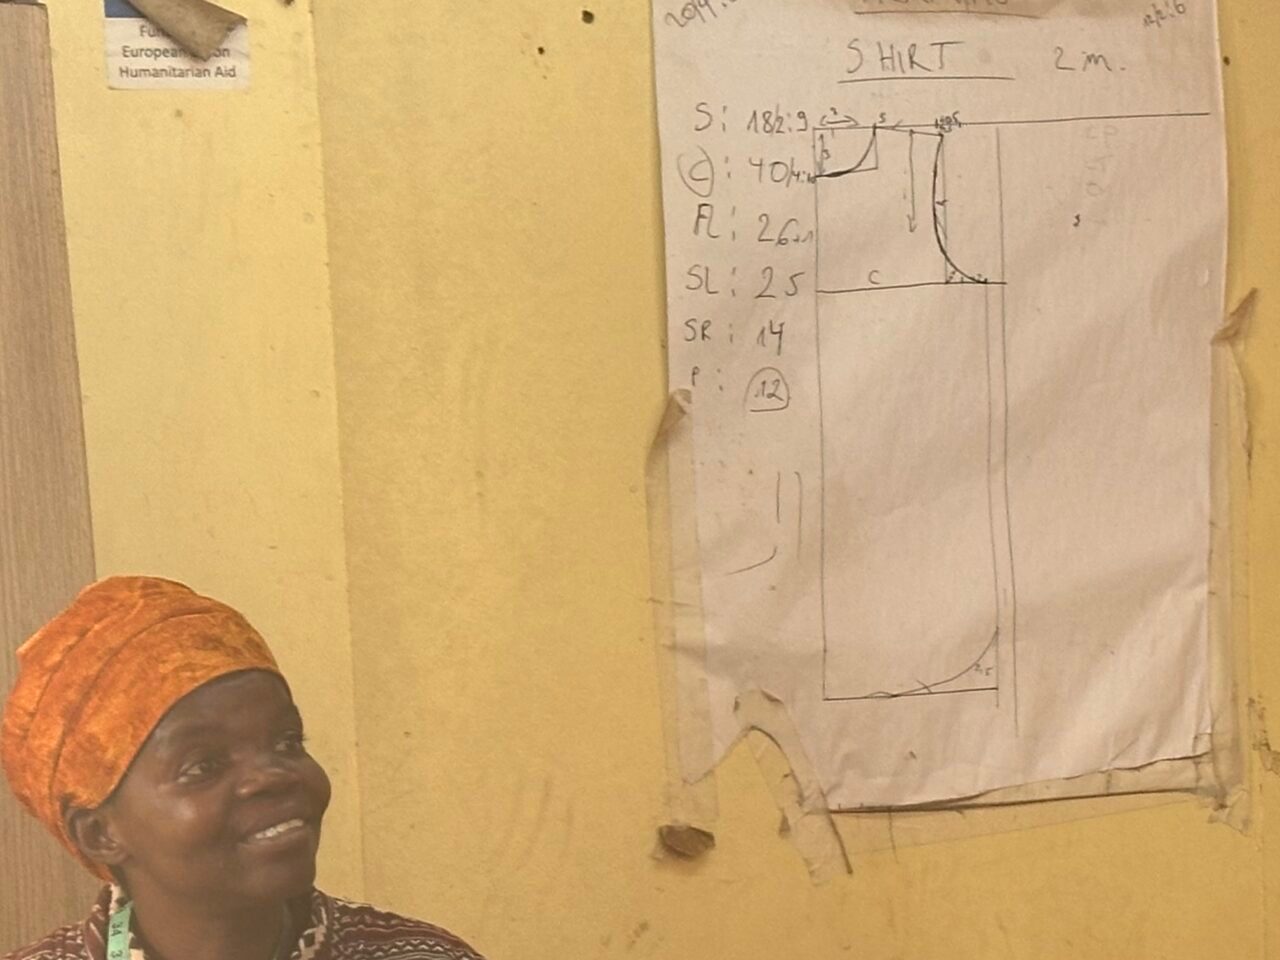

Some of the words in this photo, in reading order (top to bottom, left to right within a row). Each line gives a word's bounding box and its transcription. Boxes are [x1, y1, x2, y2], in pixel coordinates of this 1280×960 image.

[122, 45, 188, 60] European
[846, 38, 965, 74] SHIRT
[119, 65, 211, 79] Humanitarian
[214, 65, 237, 79] Aid
